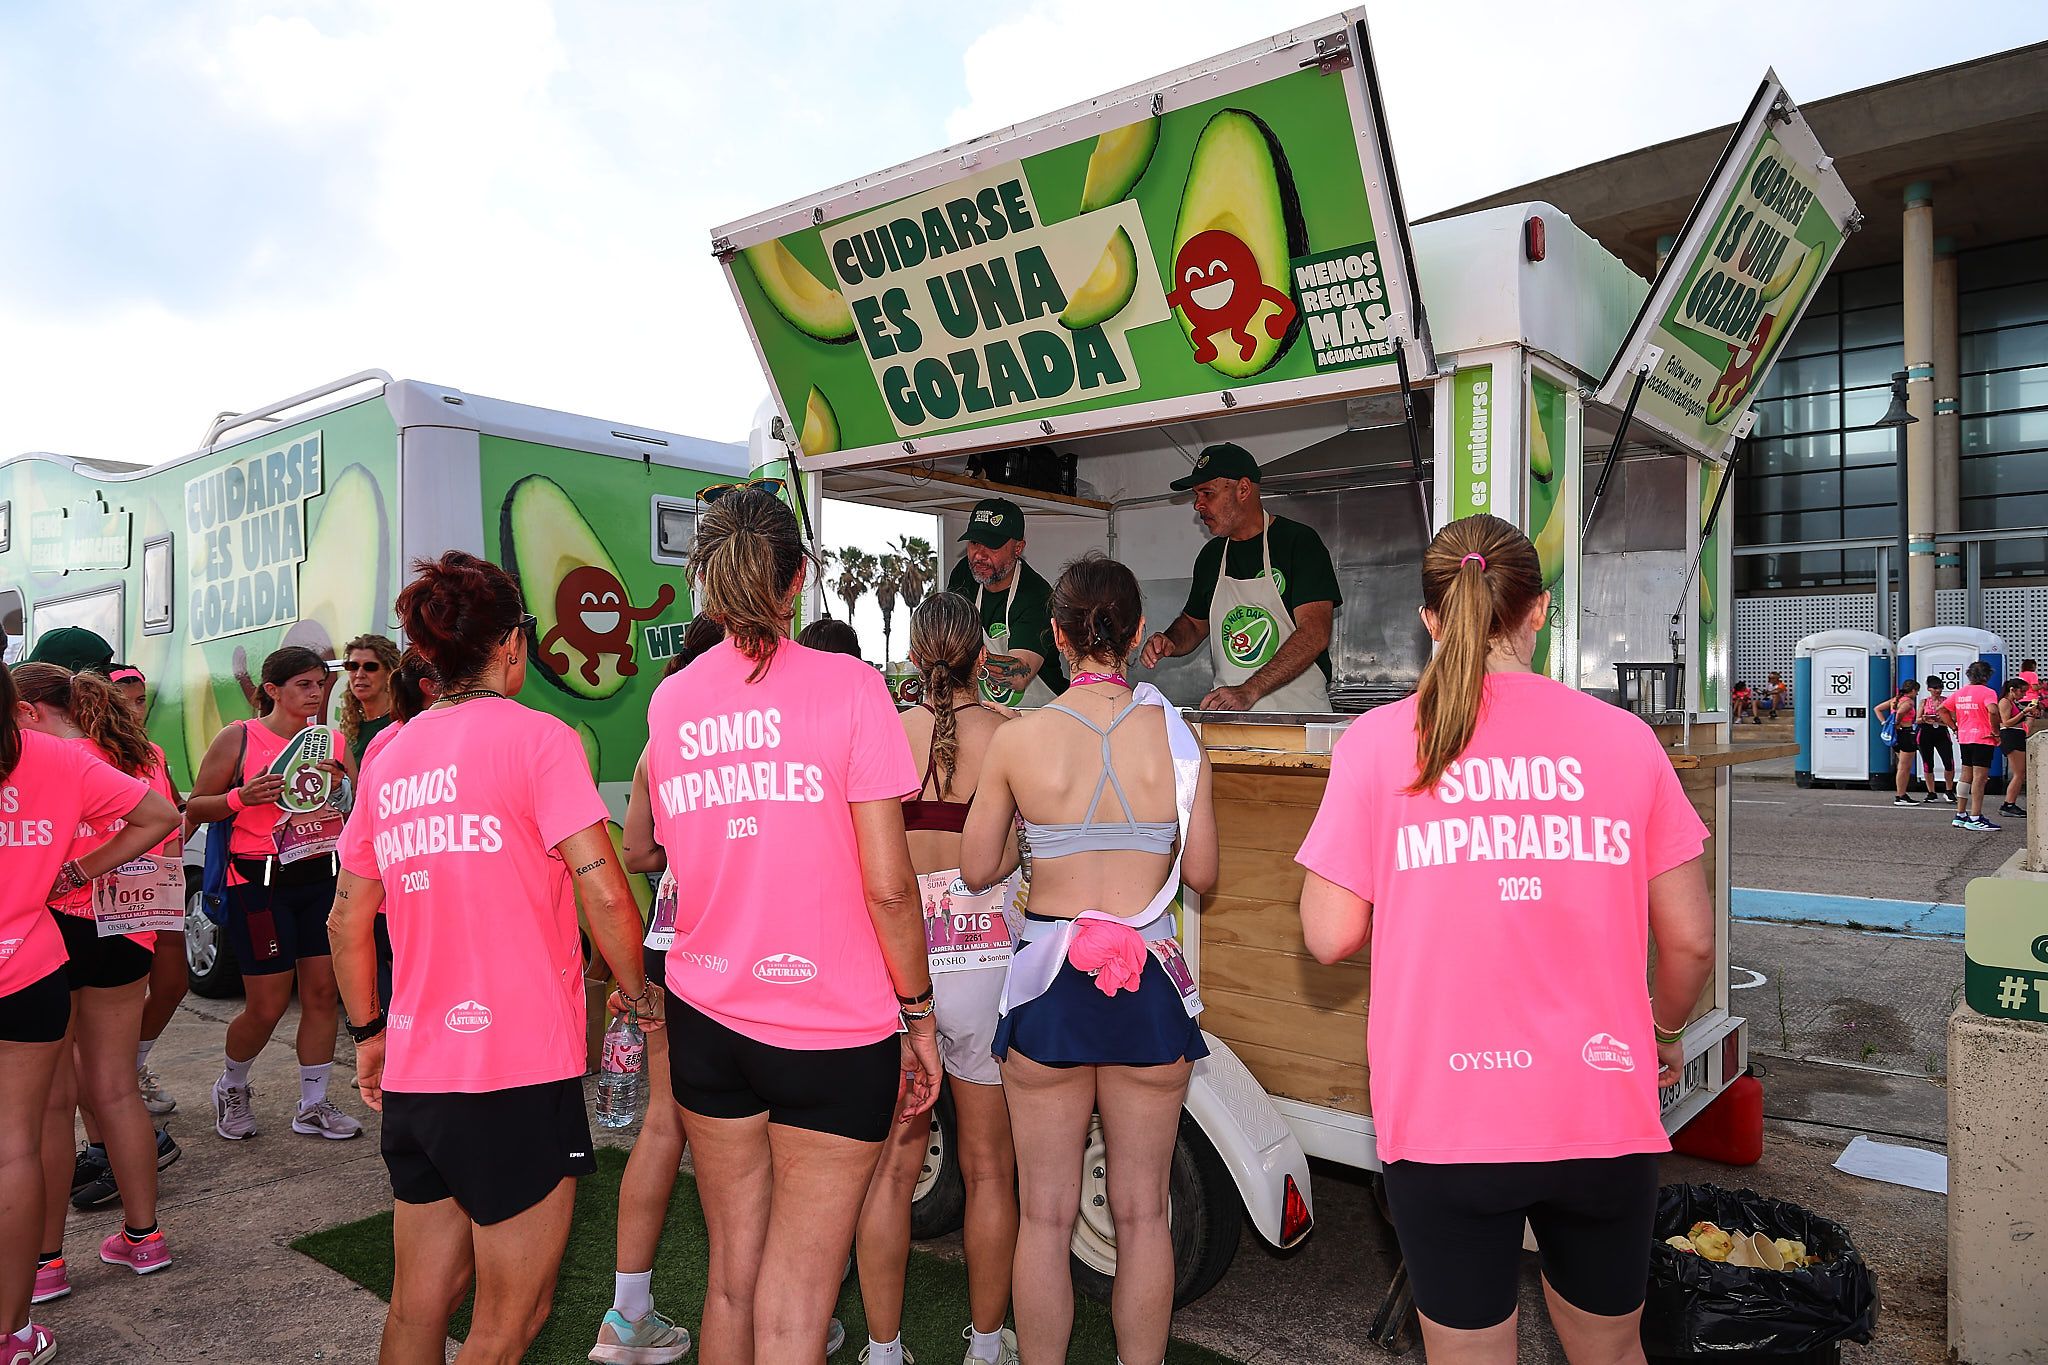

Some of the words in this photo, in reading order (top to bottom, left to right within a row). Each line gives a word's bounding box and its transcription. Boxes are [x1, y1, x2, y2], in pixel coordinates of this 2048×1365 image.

[1750, 155, 1814, 227] CUIDARSE
[832, 178, 1035, 286] CUIDARSE
[1713, 204, 1754, 263] ES
[1738, 219, 1790, 285] UNA
[1295, 251, 1378, 290] MENOS
[851, 287, 923, 360] ES
[926, 245, 1068, 339] UNA
[1301, 277, 1383, 313] REGLAS
[1685, 267, 1767, 342] GOZADA
[1307, 303, 1388, 351] MÁS
[1318, 341, 1393, 366] AGUACATES
[1664, 354, 1687, 380] Follow
[882, 323, 1127, 427] GOZADA
[1467, 381, 1488, 475] cuidarse
[187, 437, 319, 534] CUIDARSE
[1471, 481, 1487, 506] es
[205, 525, 233, 583] ES
[241, 503, 303, 572] UNA
[190, 564, 297, 641] GOZADA
[1228, 609, 1245, 625] NICE
[1246, 608, 1265, 620] DAY
[645, 622, 692, 660] HE
[678, 707, 782, 761] SOMOS
[378, 763, 458, 820] SOMOS
[1439, 755, 1585, 804] SOMOS
[295, 821, 323, 835] 016
[373, 813, 503, 876] MPARABLES
[726, 816, 758, 839] 026
[1396, 814, 1631, 871] IMPARABLES
[401, 869, 430, 893] 2026
[575, 857, 607, 877] Kenzo
[927, 881, 947, 889] SUMA
[119, 888, 155, 904] 016
[1497, 876, 1543, 901] 2026
[953, 913, 992, 933] 016
[964, 934, 983, 942] 2261
[682, 951, 729, 974] OYSHO
[930, 944, 955, 954] CARRERA
[932, 956, 967, 967] OYSHO
[757, 964, 812, 977] ASTURIANA
[1449, 1049, 1533, 1072] OYSHO
